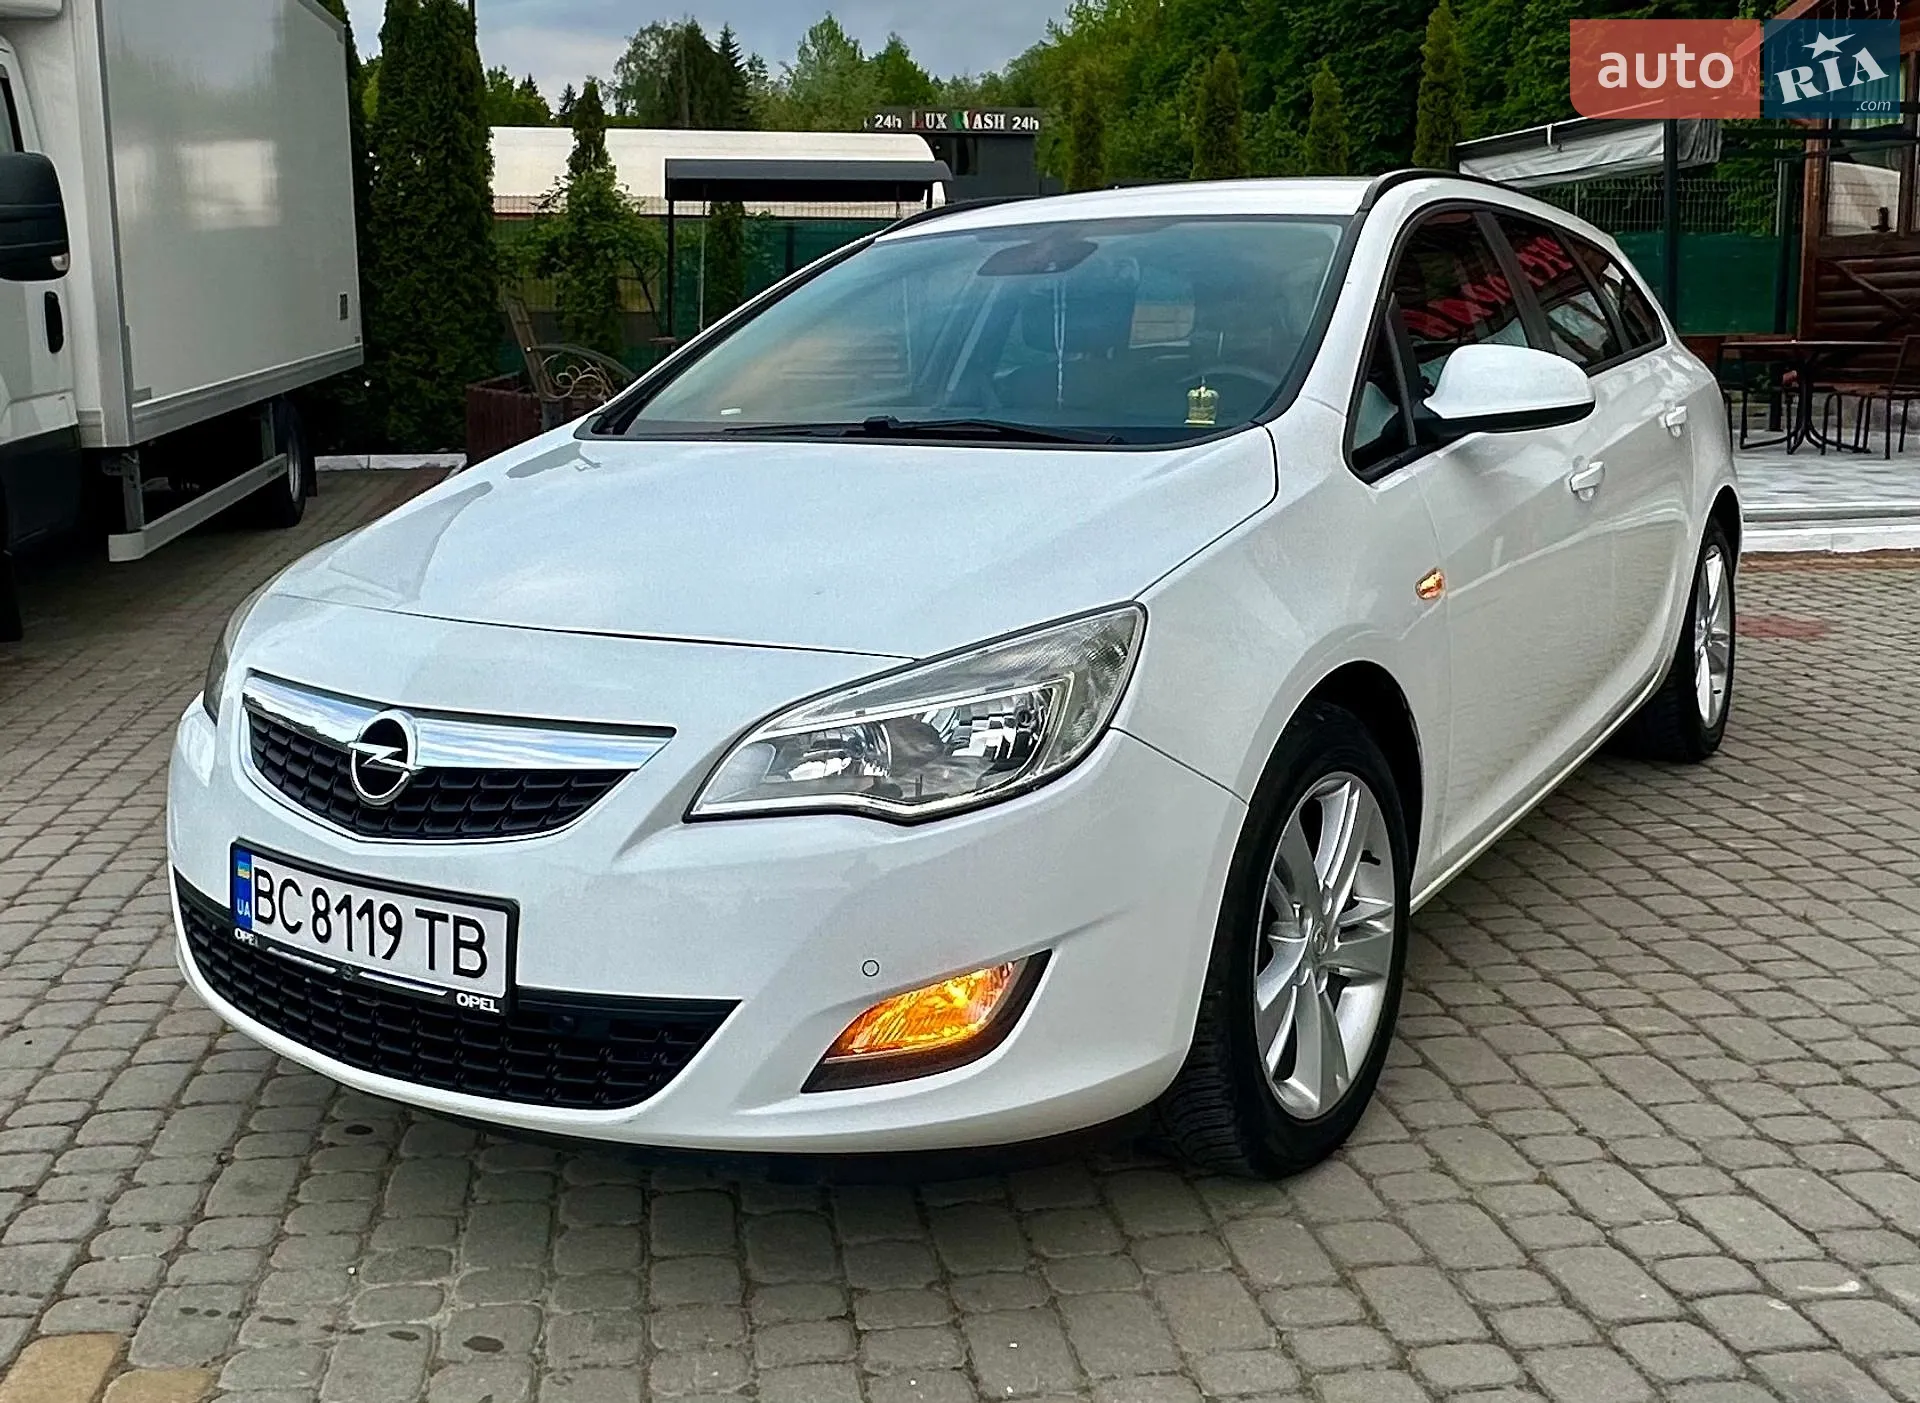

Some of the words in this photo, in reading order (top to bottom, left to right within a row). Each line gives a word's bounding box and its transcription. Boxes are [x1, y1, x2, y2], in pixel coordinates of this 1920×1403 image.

[874, 114, 902, 129] 24h
[911, 109, 948, 129] LUX
[952, 108, 1006, 130] WASH
[1012, 116, 1039, 130] 24h
[237, 898, 251, 918] UA
[253, 867, 303, 934] BC
[311, 887, 403, 961] 8119
[414, 907, 488, 979] TB
[456, 992, 500, 1013] OPEL
